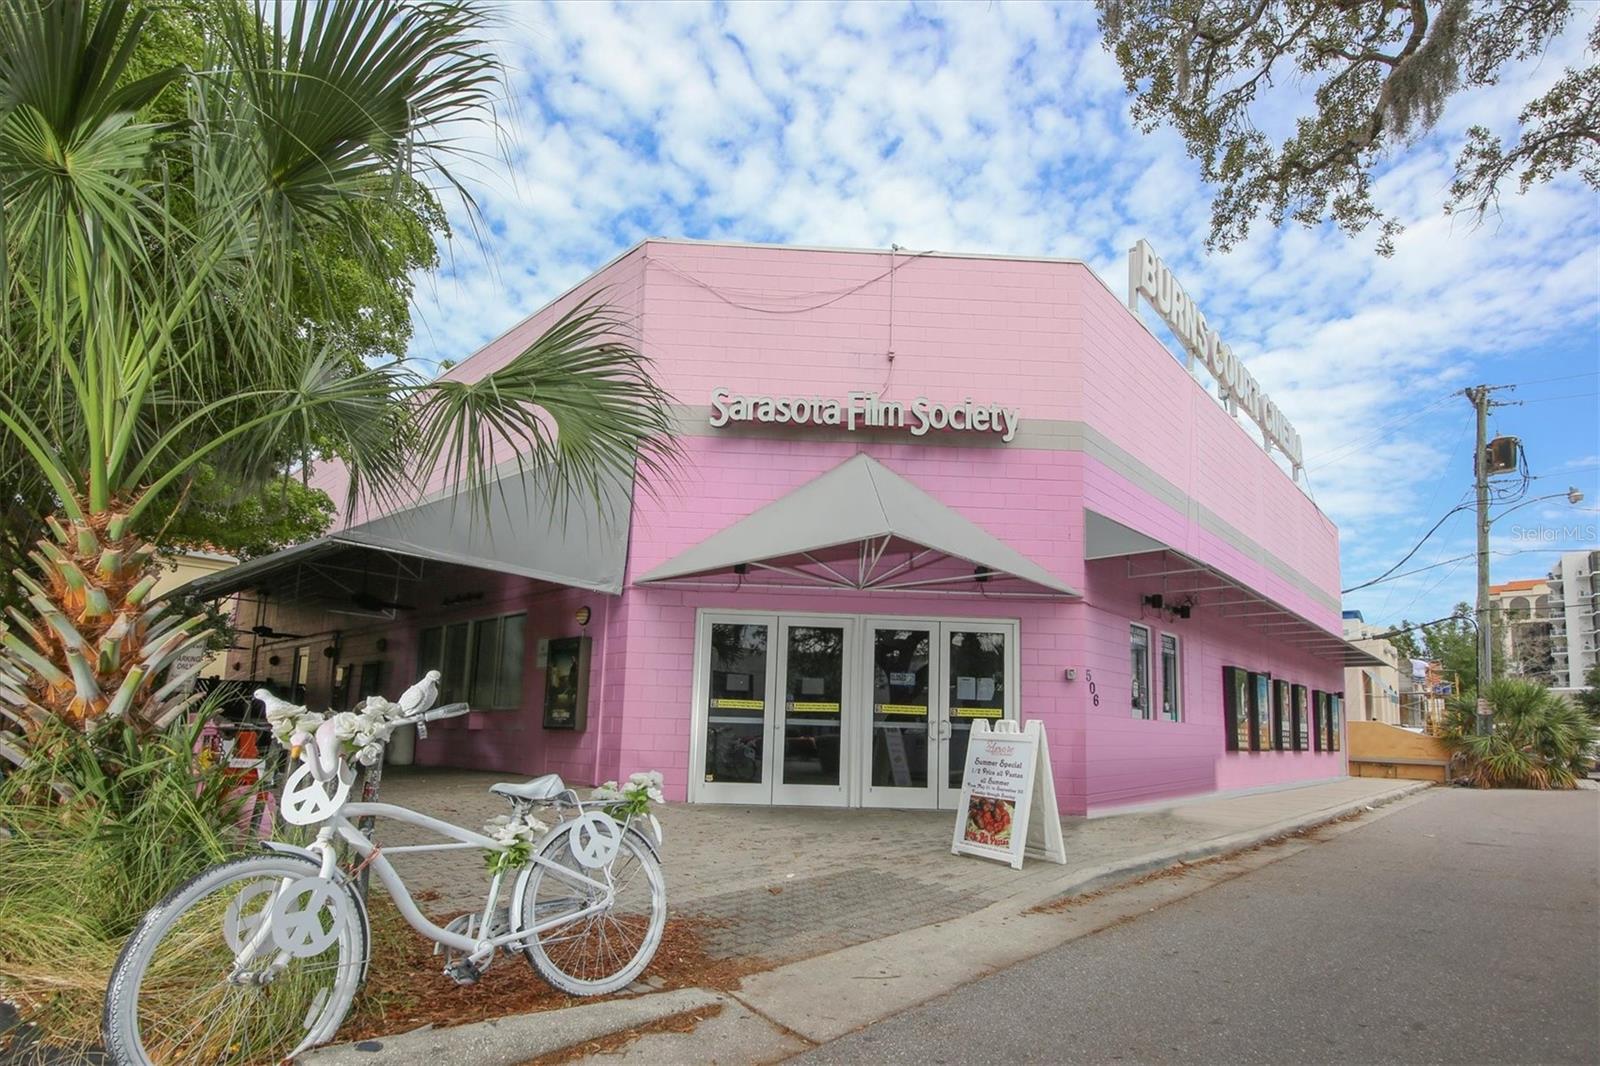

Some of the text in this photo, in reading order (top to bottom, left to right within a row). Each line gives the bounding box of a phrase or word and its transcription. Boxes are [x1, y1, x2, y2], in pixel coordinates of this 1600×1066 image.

[1136, 238, 1208, 360] BURNS
[1210, 330, 1260, 421] COURT
[709, 386, 1020, 442] Sarasota Film Society
[1086, 669, 1099, 707] 506
[974, 757, 1023, 769] Summer Special
[987, 777, 1010, 786] Summer
